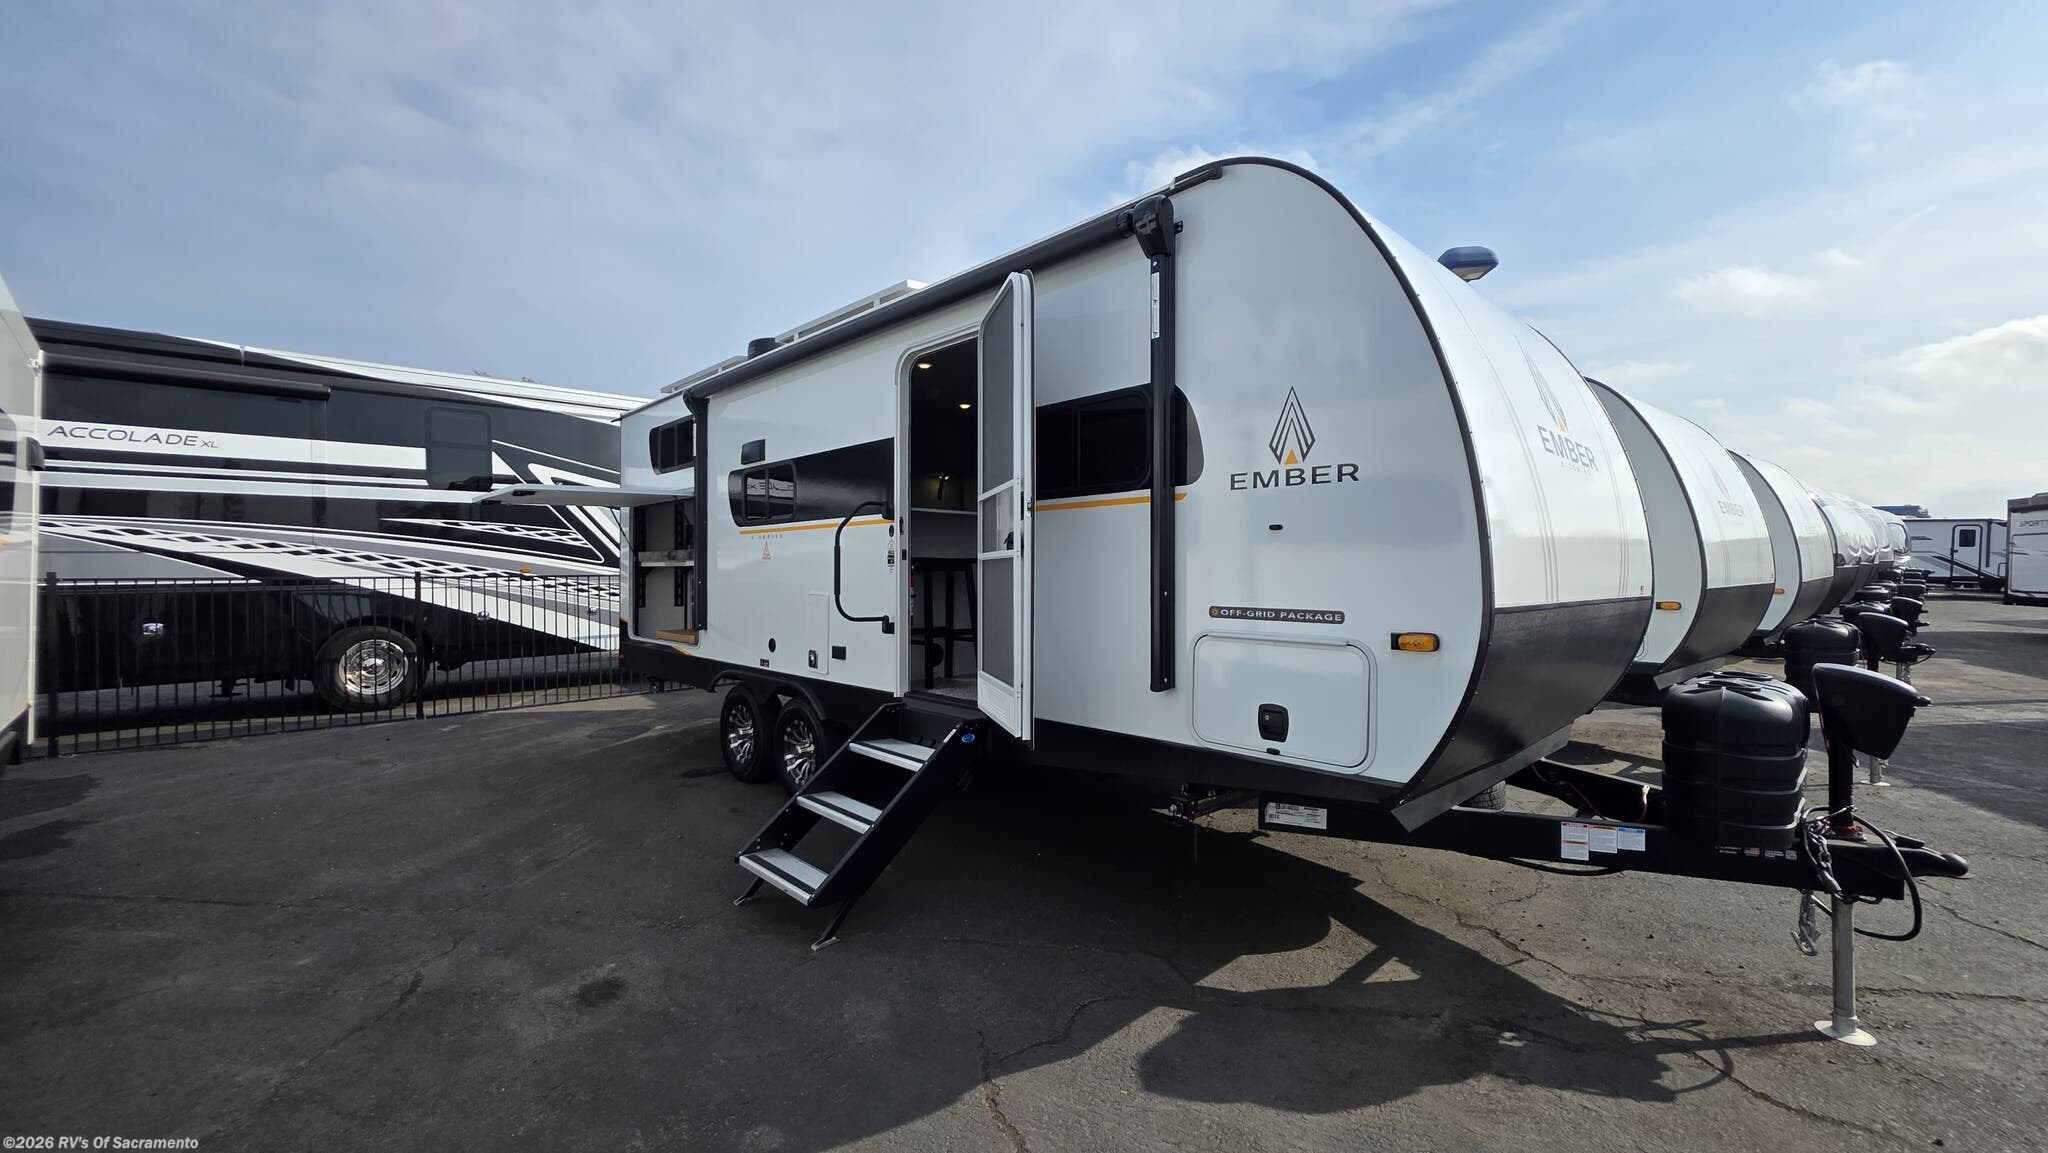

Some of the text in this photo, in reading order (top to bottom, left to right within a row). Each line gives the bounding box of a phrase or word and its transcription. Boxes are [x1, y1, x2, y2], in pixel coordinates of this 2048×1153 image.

[47, 425, 219, 449] ACCOLADE XL
[1537, 424, 1599, 472] EMBER
[1230, 463, 1360, 491] EMBER
[1220, 608, 1342, 622] OFF-GRID PACKAGE
